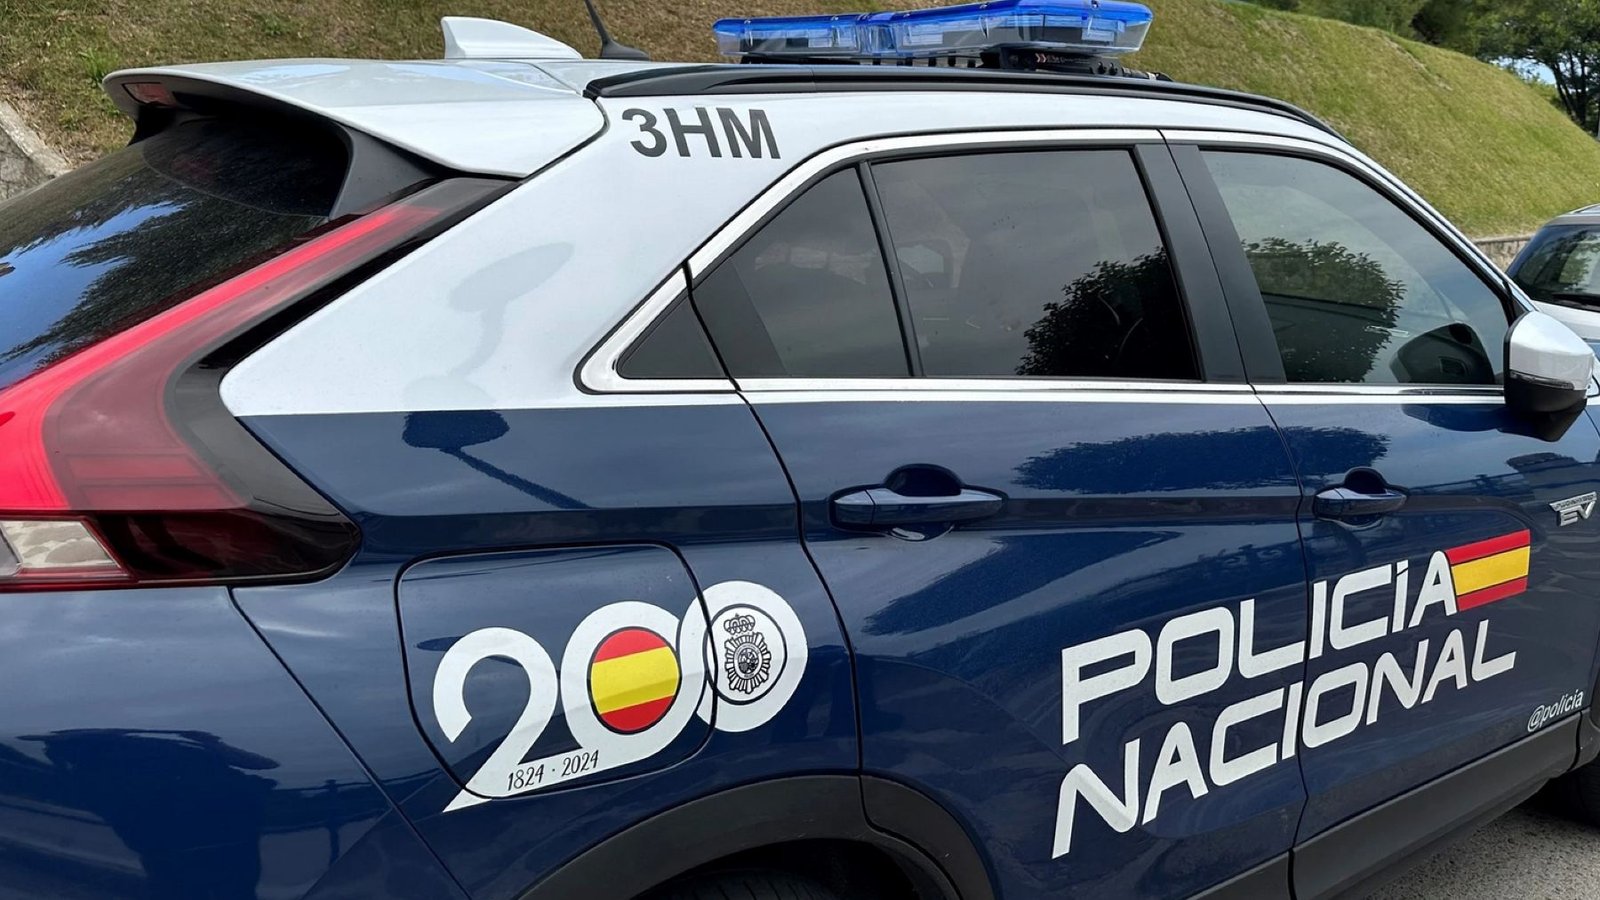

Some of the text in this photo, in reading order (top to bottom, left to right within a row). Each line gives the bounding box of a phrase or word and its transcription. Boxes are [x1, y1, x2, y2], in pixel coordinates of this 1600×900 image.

[622, 107, 781, 160] 3HM
[1052, 619, 1516, 859] NACIONAL
[507, 750, 599, 791] 1824 2024
